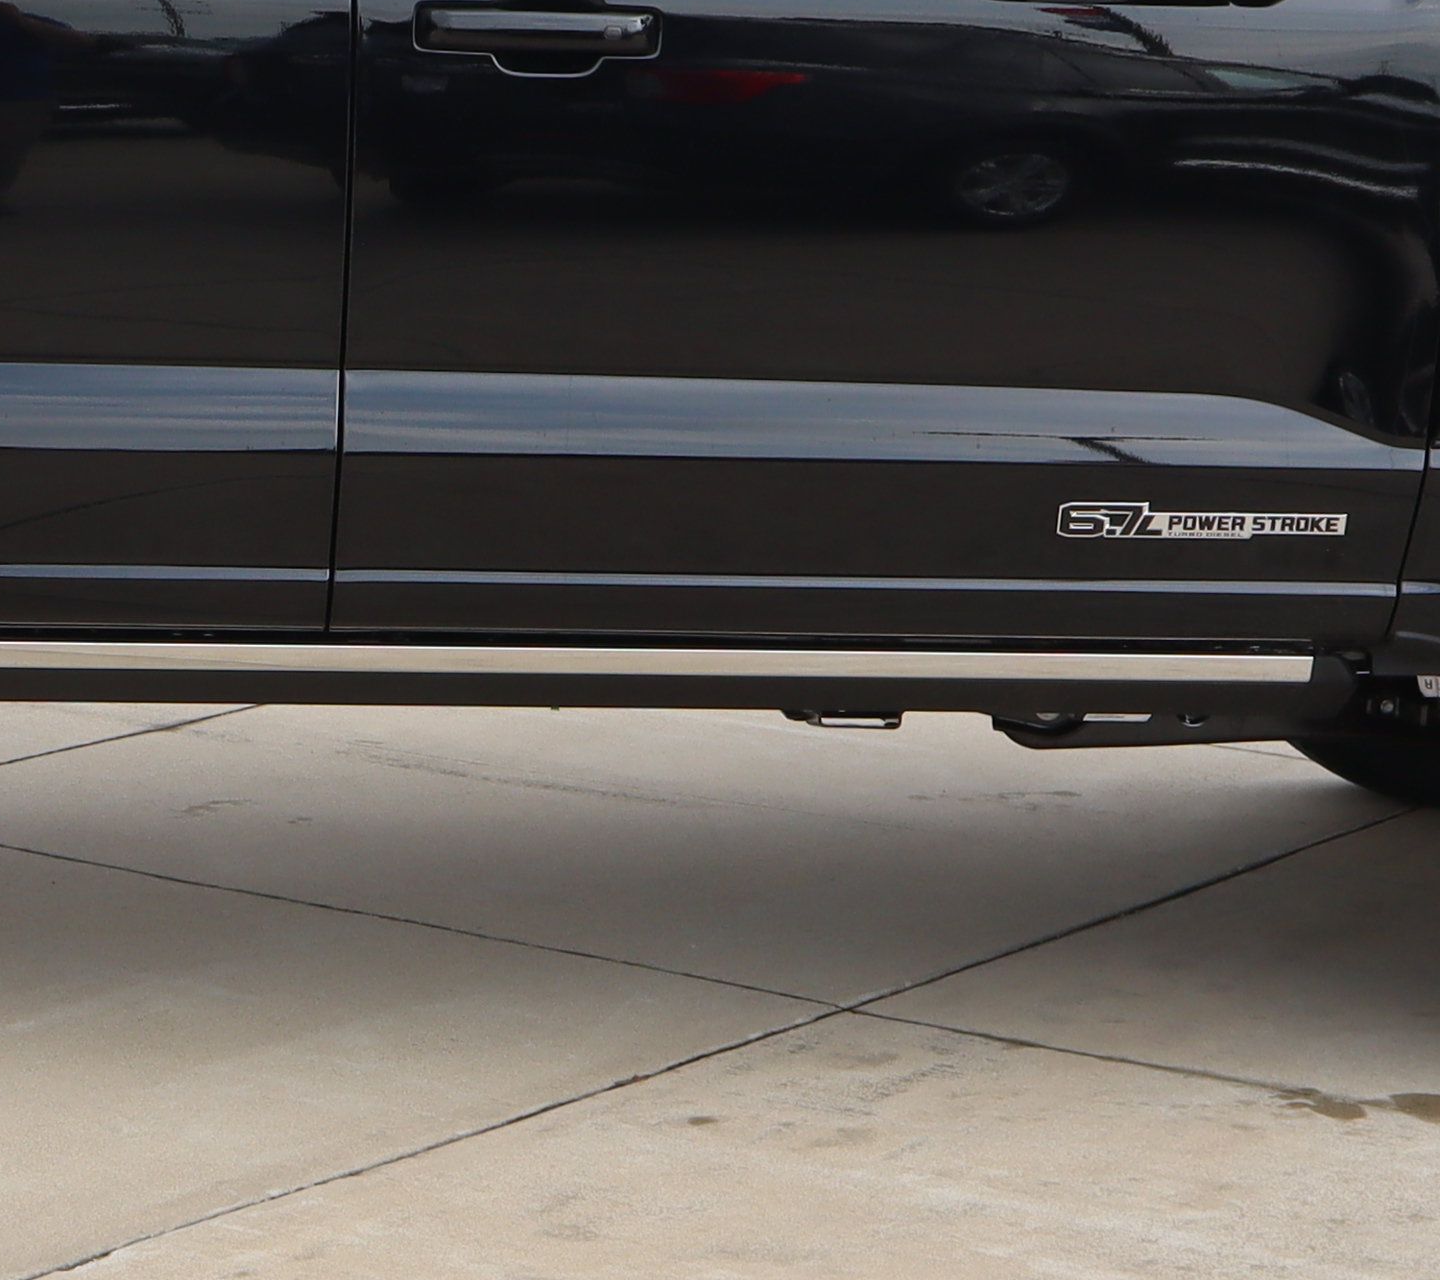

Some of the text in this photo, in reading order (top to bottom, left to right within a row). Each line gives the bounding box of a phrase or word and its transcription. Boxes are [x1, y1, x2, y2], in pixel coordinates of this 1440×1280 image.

[1056, 502, 1339, 538] 6.7L POWER STROKE
